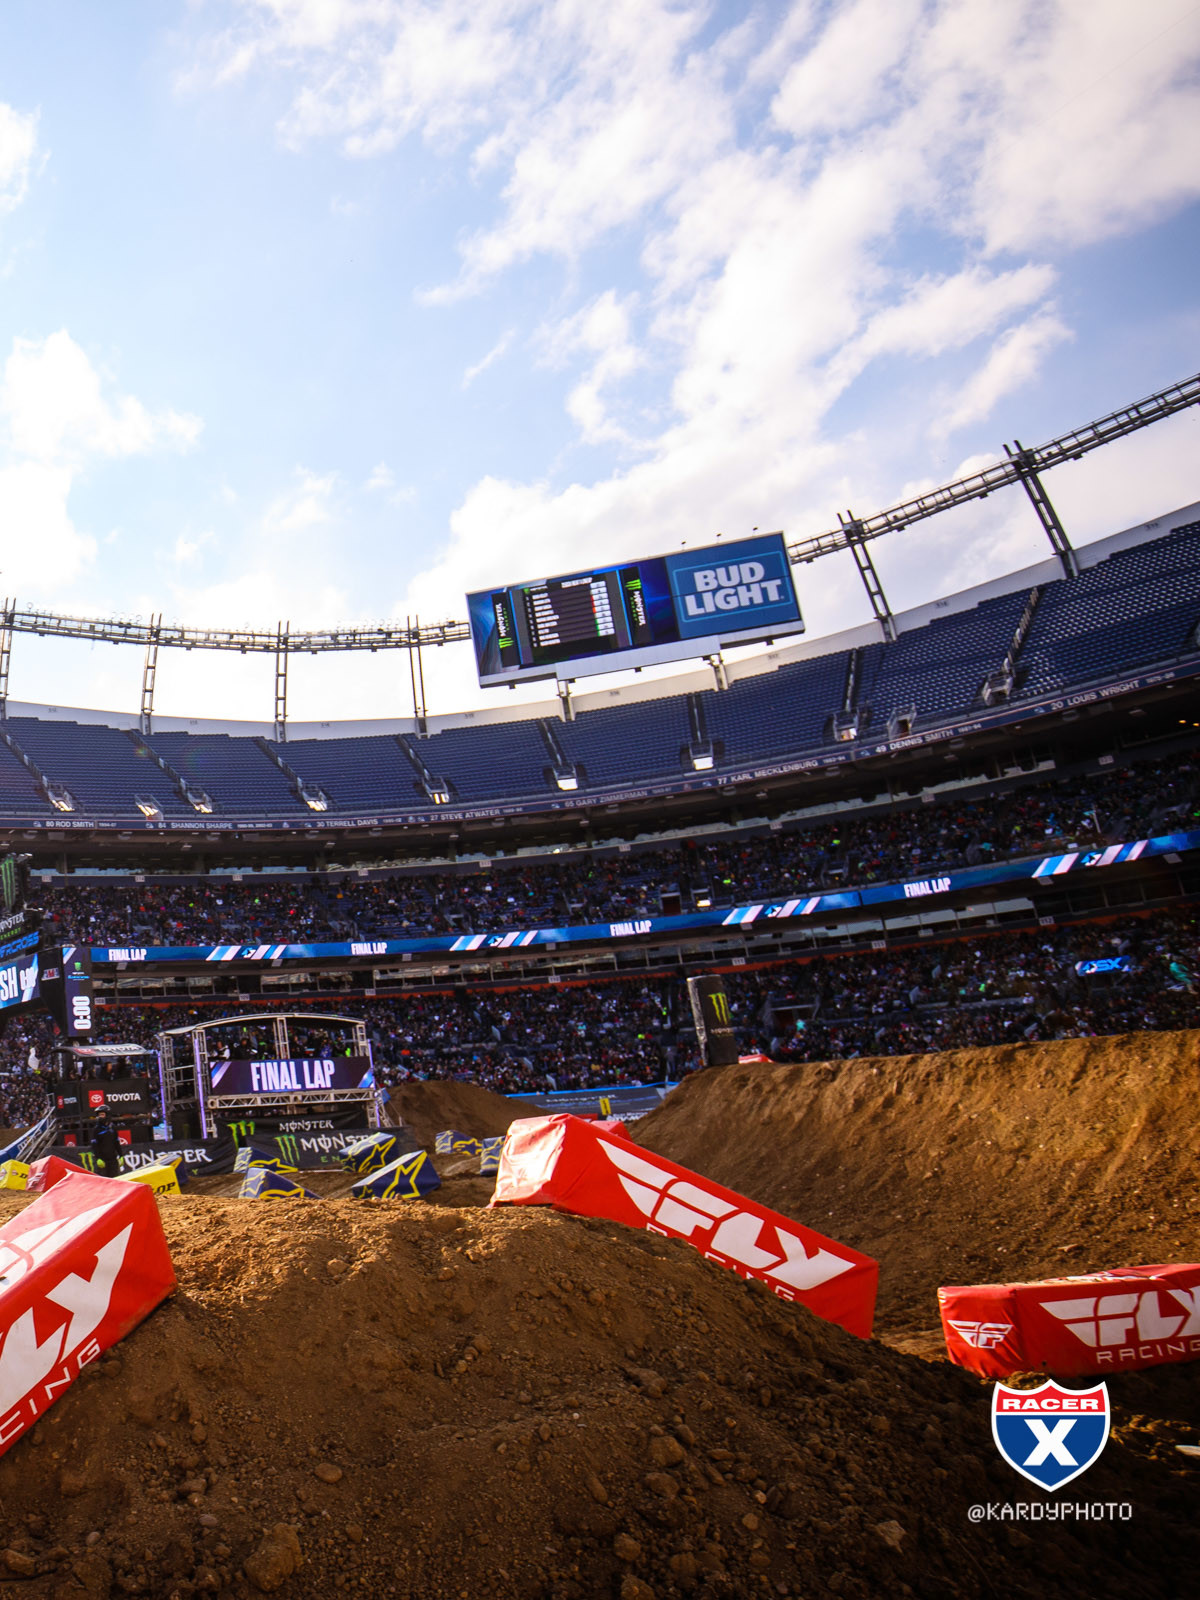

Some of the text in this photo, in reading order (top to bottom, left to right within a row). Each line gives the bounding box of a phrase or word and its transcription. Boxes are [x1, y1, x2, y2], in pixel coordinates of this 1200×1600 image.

[694, 562, 765, 592] BUD
[685, 579, 782, 616] LIGHT
[1052, 702, 1063, 711] 20
[1067, 691, 1097, 706] LOUIS
[1099, 680, 1140, 698] WRIGHT
[889, 736, 923, 750] DENNIS
[925, 729, 953, 743] SMITH
[718, 777, 727, 785] 77
[731, 773, 753, 783] KARL
[754, 760, 818, 779] MECKLENBURG
[575, 798, 599, 807] GARY
[326, 820, 355, 828] TERRELL
[357, 818, 378, 826] DAVIS
[441, 812, 462, 821] STEVE
[465, 809, 500, 819] ATWATER
[171, 821, 204, 829] SHANNON
[903, 877, 951, 898] FINAL LAP
[610, 920, 651, 936] FINAL LAP
[108, 948, 147, 961] FINAL LAP
[351, 942, 388, 955] FINAL LAP
[72, 996, 91, 1030] 0:00
[250, 1059, 335, 1091] FINAL LAP
[106, 1092, 141, 1102] TOYOTA
[279, 1119, 334, 1133] MONSTER
[596, 1137, 856, 1290] FLY
